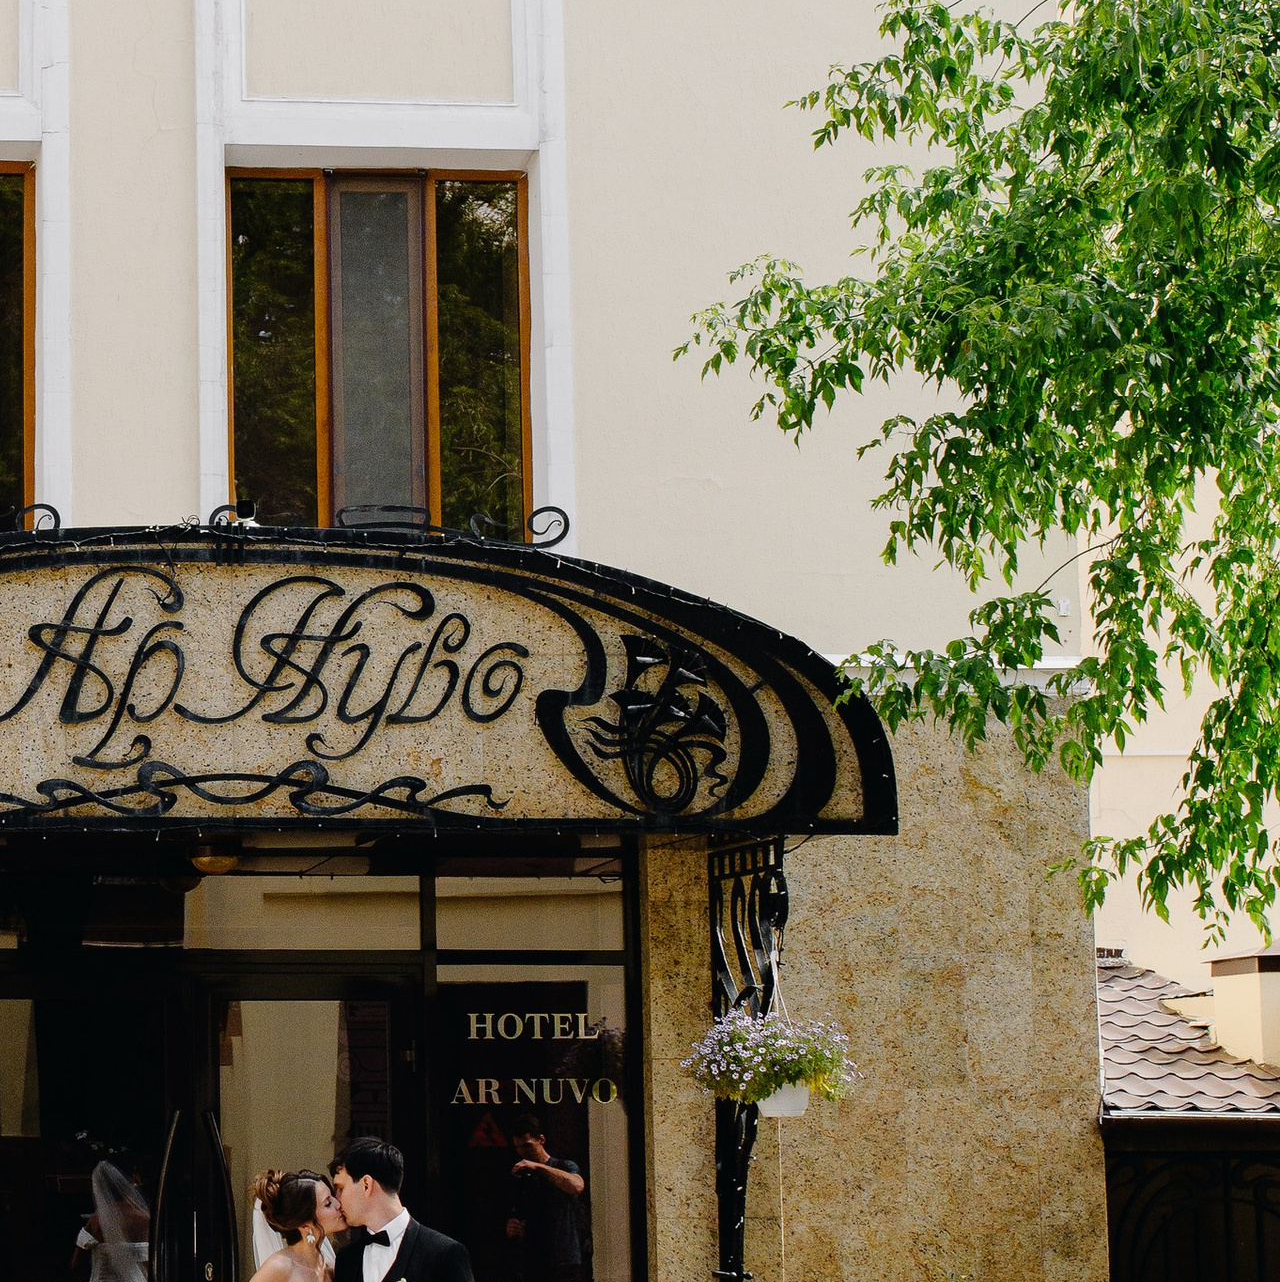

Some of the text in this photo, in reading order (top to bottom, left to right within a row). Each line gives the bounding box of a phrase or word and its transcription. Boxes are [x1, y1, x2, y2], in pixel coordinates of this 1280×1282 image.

[467, 1013, 600, 1039] HOTEL
[450, 1078, 617, 1104] AR NUVO
